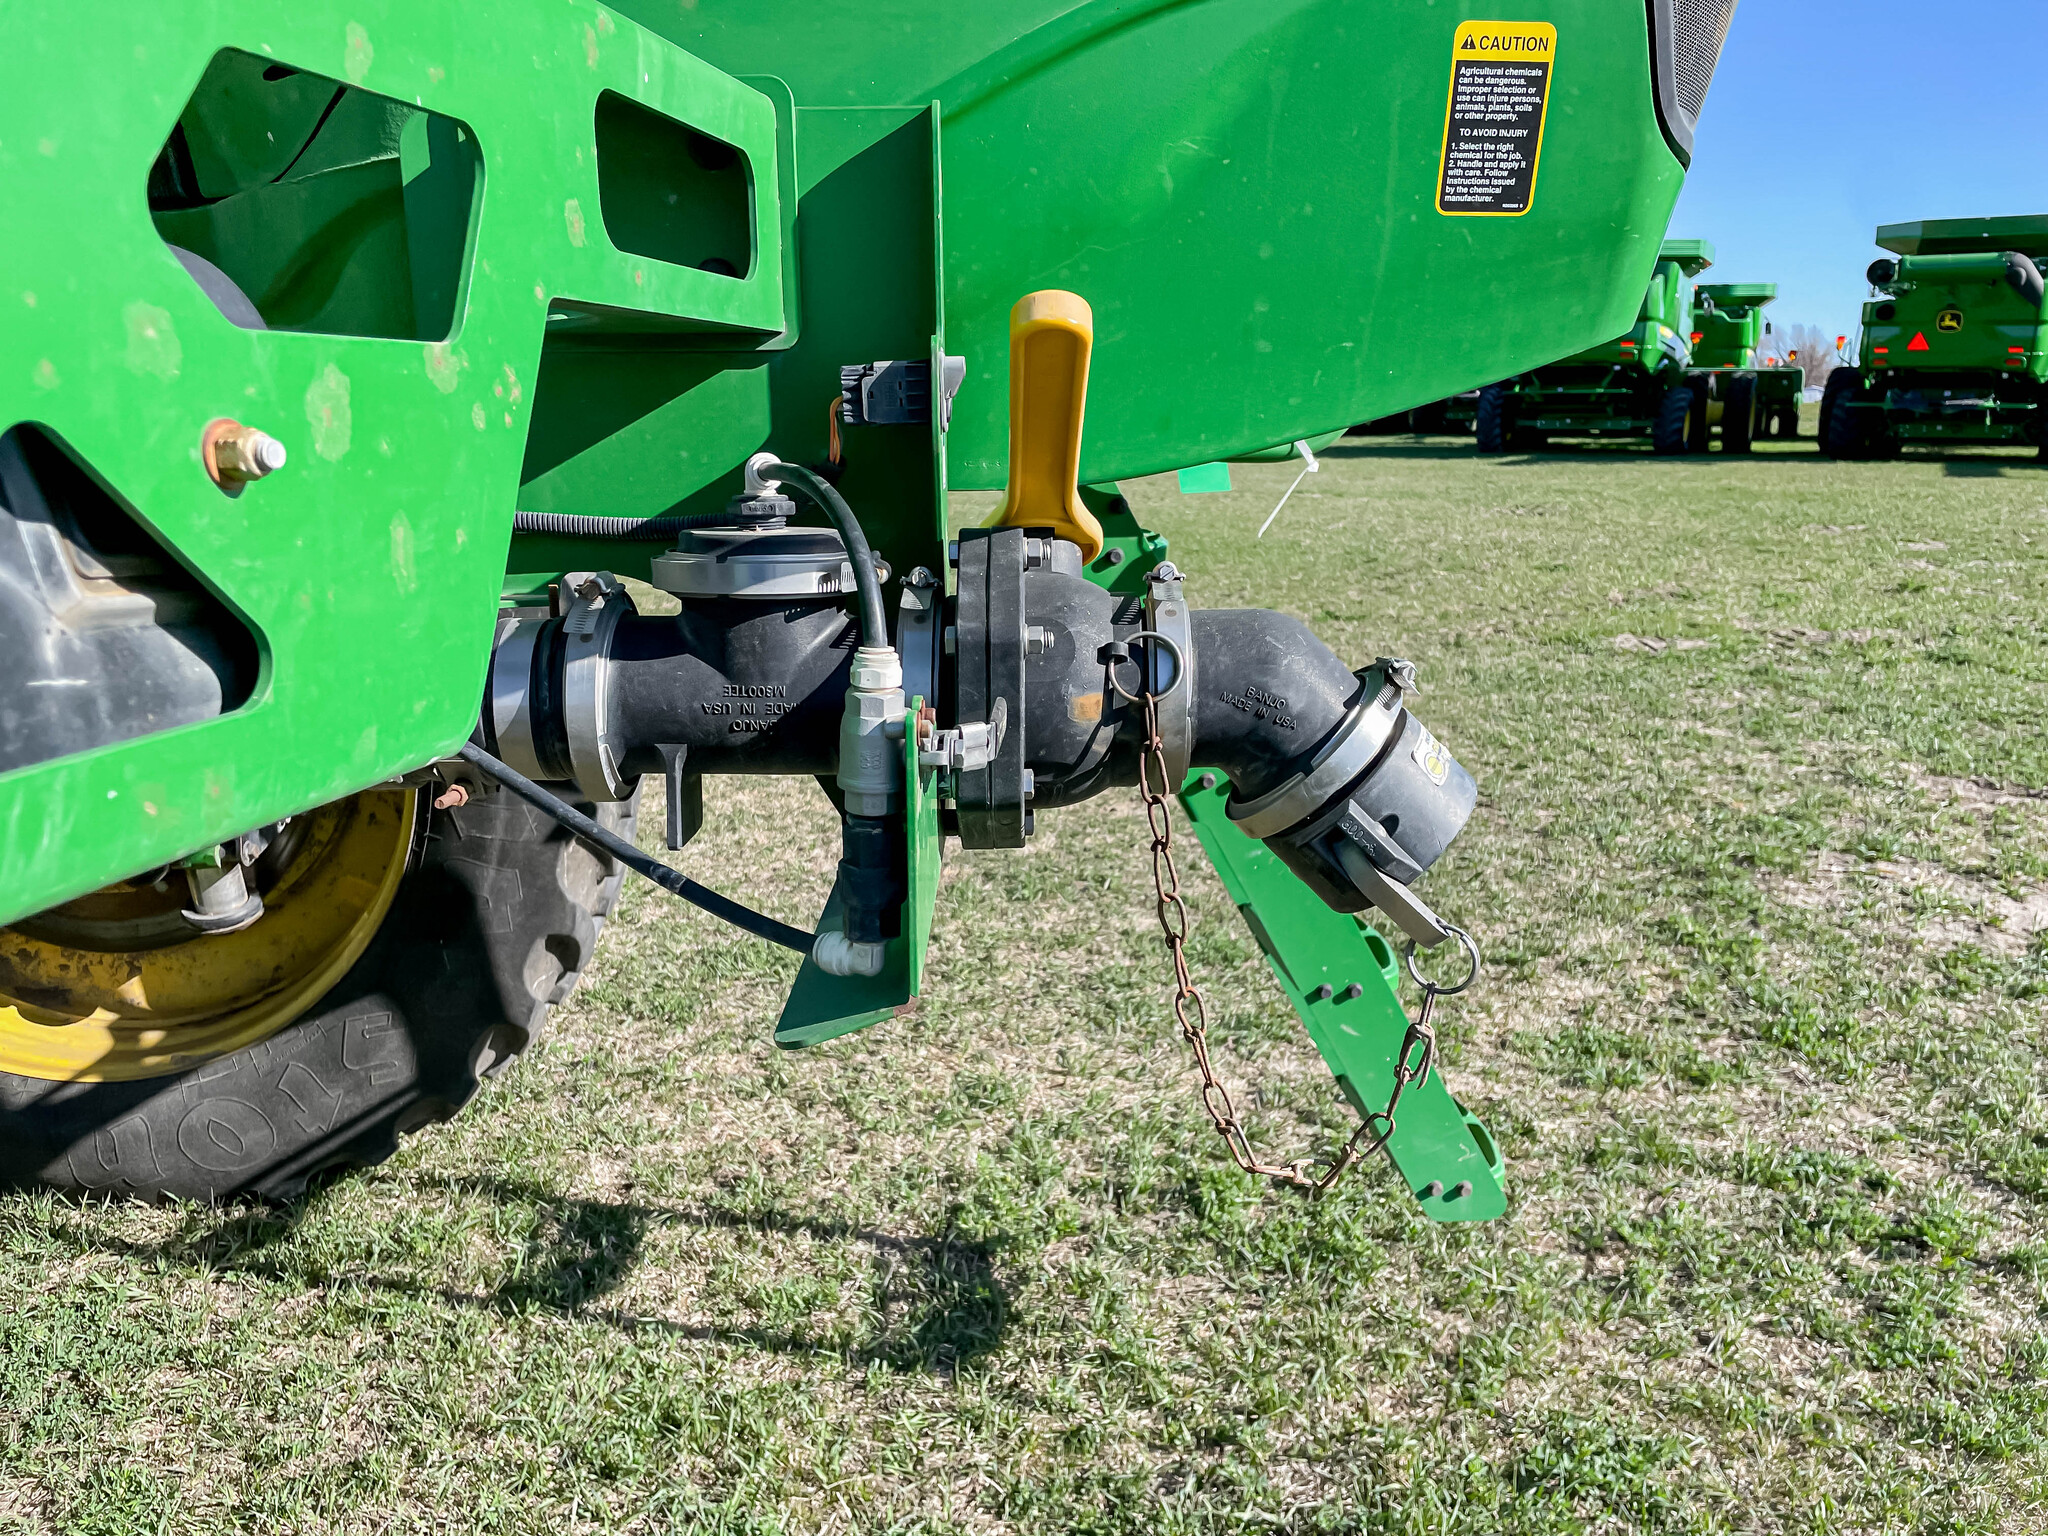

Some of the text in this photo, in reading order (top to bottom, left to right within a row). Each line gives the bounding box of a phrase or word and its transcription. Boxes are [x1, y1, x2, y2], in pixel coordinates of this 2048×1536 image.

[1480, 36, 1549, 51] CAUTION
[1460, 67, 1542, 76] Agricultural chemicals
[1485, 77, 1526, 85] dangerous.
[1458, 85, 1491, 94] Improper
[1488, 95, 1508, 103] injure
[1456, 103, 1486, 111] animals,
[1488, 104, 1513, 112] plants,
[1485, 113, 1518, 122] property.
[1497, 143, 1514, 152] right
[1509, 152, 1522, 160] job.
[1500, 161, 1519, 169] apply
[1446, 186, 1455, 194] by
[1246, 686, 1286, 709] BANJO
[703, 703, 732, 714] USA
[766, 703, 796, 714] ADE
[1220, 691, 1296, 730] MADE IN USA
